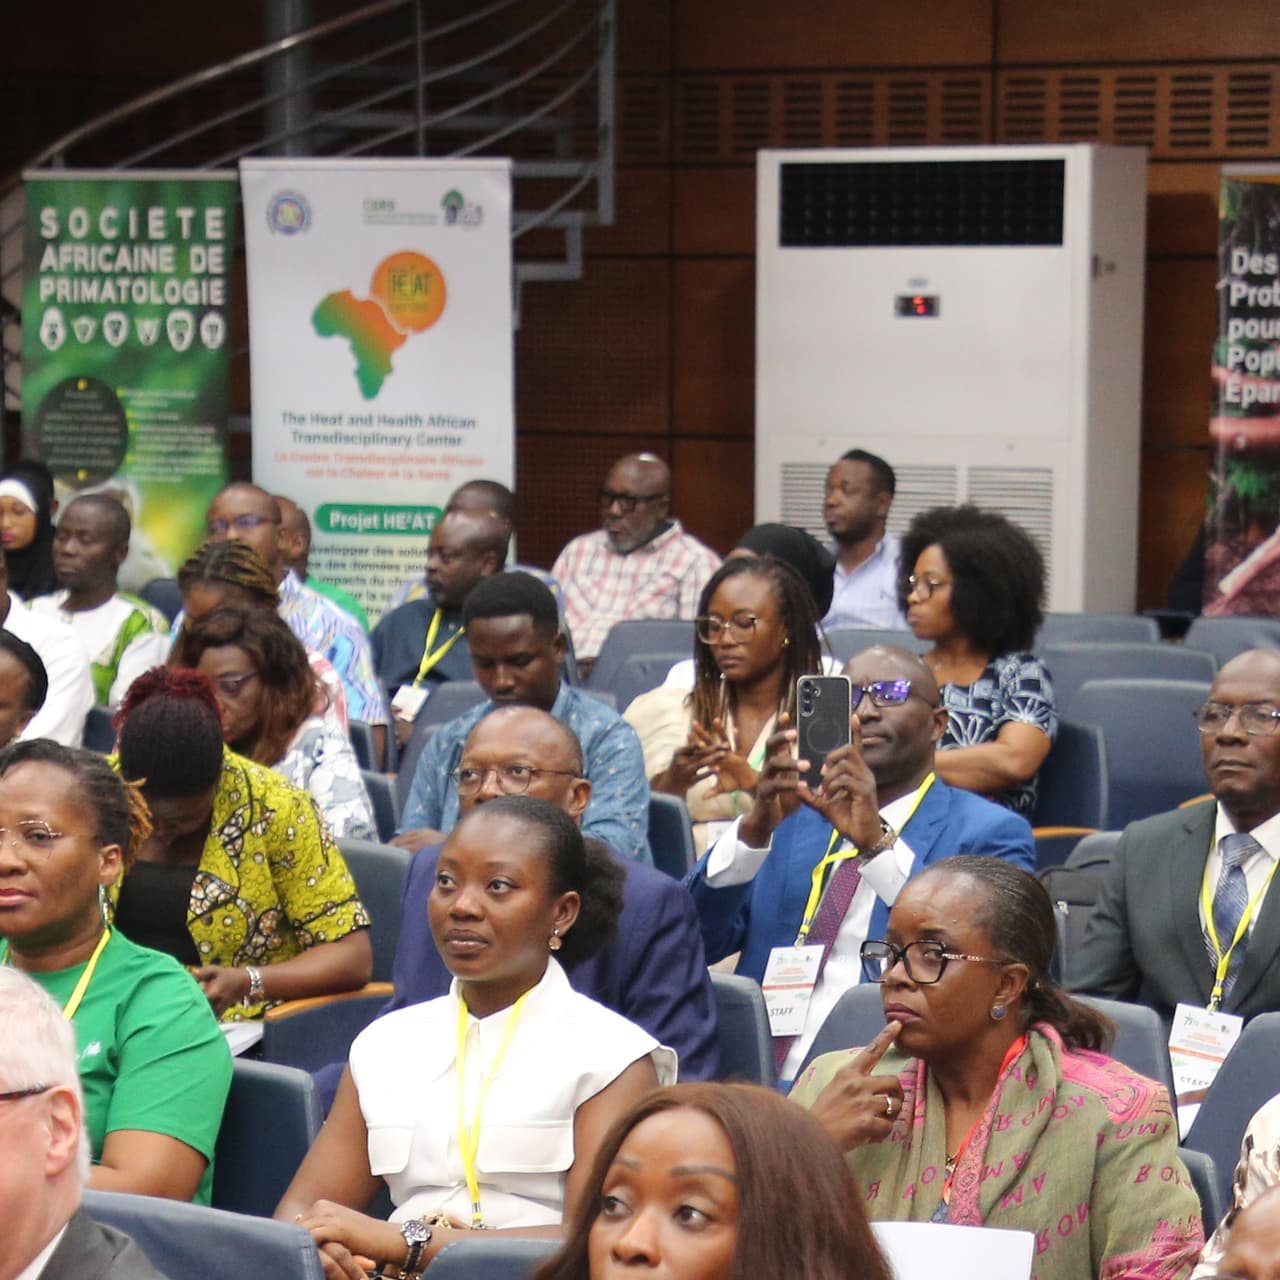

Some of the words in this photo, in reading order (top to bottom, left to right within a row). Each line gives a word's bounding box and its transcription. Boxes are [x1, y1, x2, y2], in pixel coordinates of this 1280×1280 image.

[40, 207, 225, 239] SOCIETE
[40, 244, 176, 272] AFRICAINE
[190, 246, 225, 274] DE
[1231, 248, 1279, 275] Des
[40, 277, 225, 305] PRIMATOLOGIE
[282, 412, 306, 425] The
[310, 413, 343, 426] Heat
[348, 414, 373, 427] and
[377, 414, 422, 428] Health
[426, 415, 477, 429] African
[291, 431, 412, 448] Transdisciplinary
[416, 433, 464, 447] Center
[329, 511, 379, 533] Projet
[770, 1007, 794, 1017] STAFF
